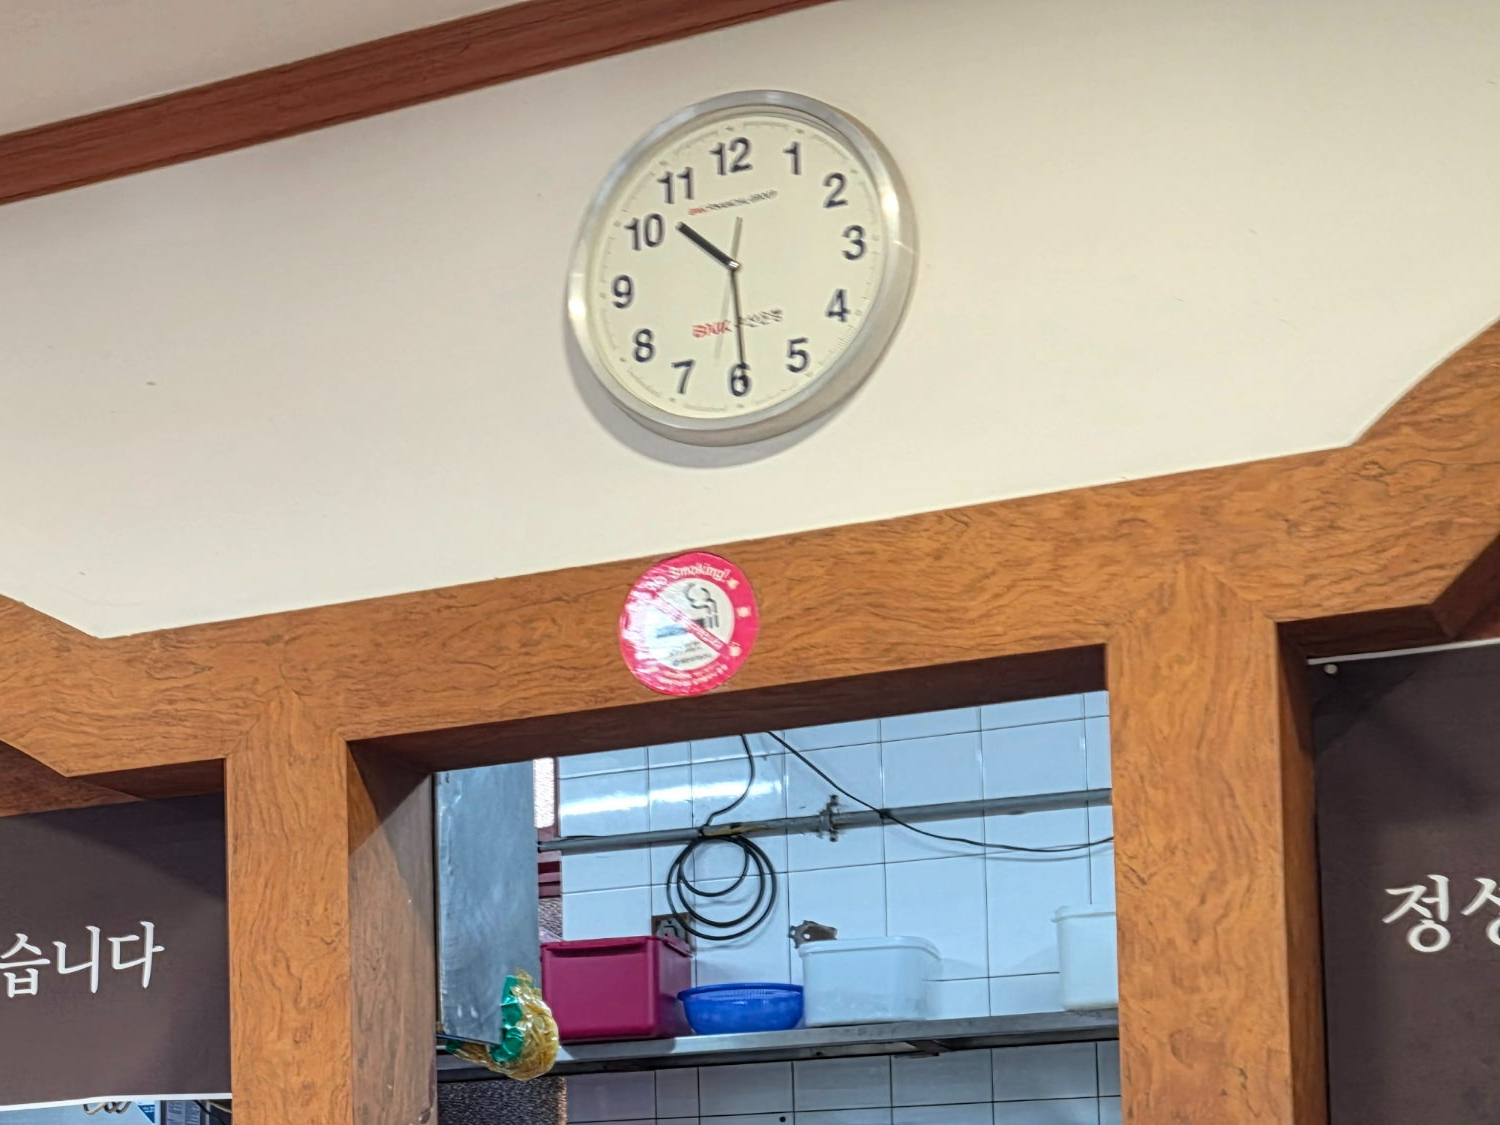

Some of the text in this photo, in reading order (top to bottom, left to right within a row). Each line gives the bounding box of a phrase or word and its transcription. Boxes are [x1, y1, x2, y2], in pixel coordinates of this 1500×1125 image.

[710, 137, 753, 176] 12
[783, 141, 802, 176] 1
[657, 166, 694, 204] 11
[822, 172, 849, 209] 2
[624, 213, 665, 251] 10
[841, 224, 867, 260] 3
[611, 274, 635, 309] 9
[825, 288, 851, 322] 4
[632, 328, 656, 363] 8
[786, 337, 810, 373] 5
[671, 358, 696, 395] 7
[729, 361, 752, 397] 6
